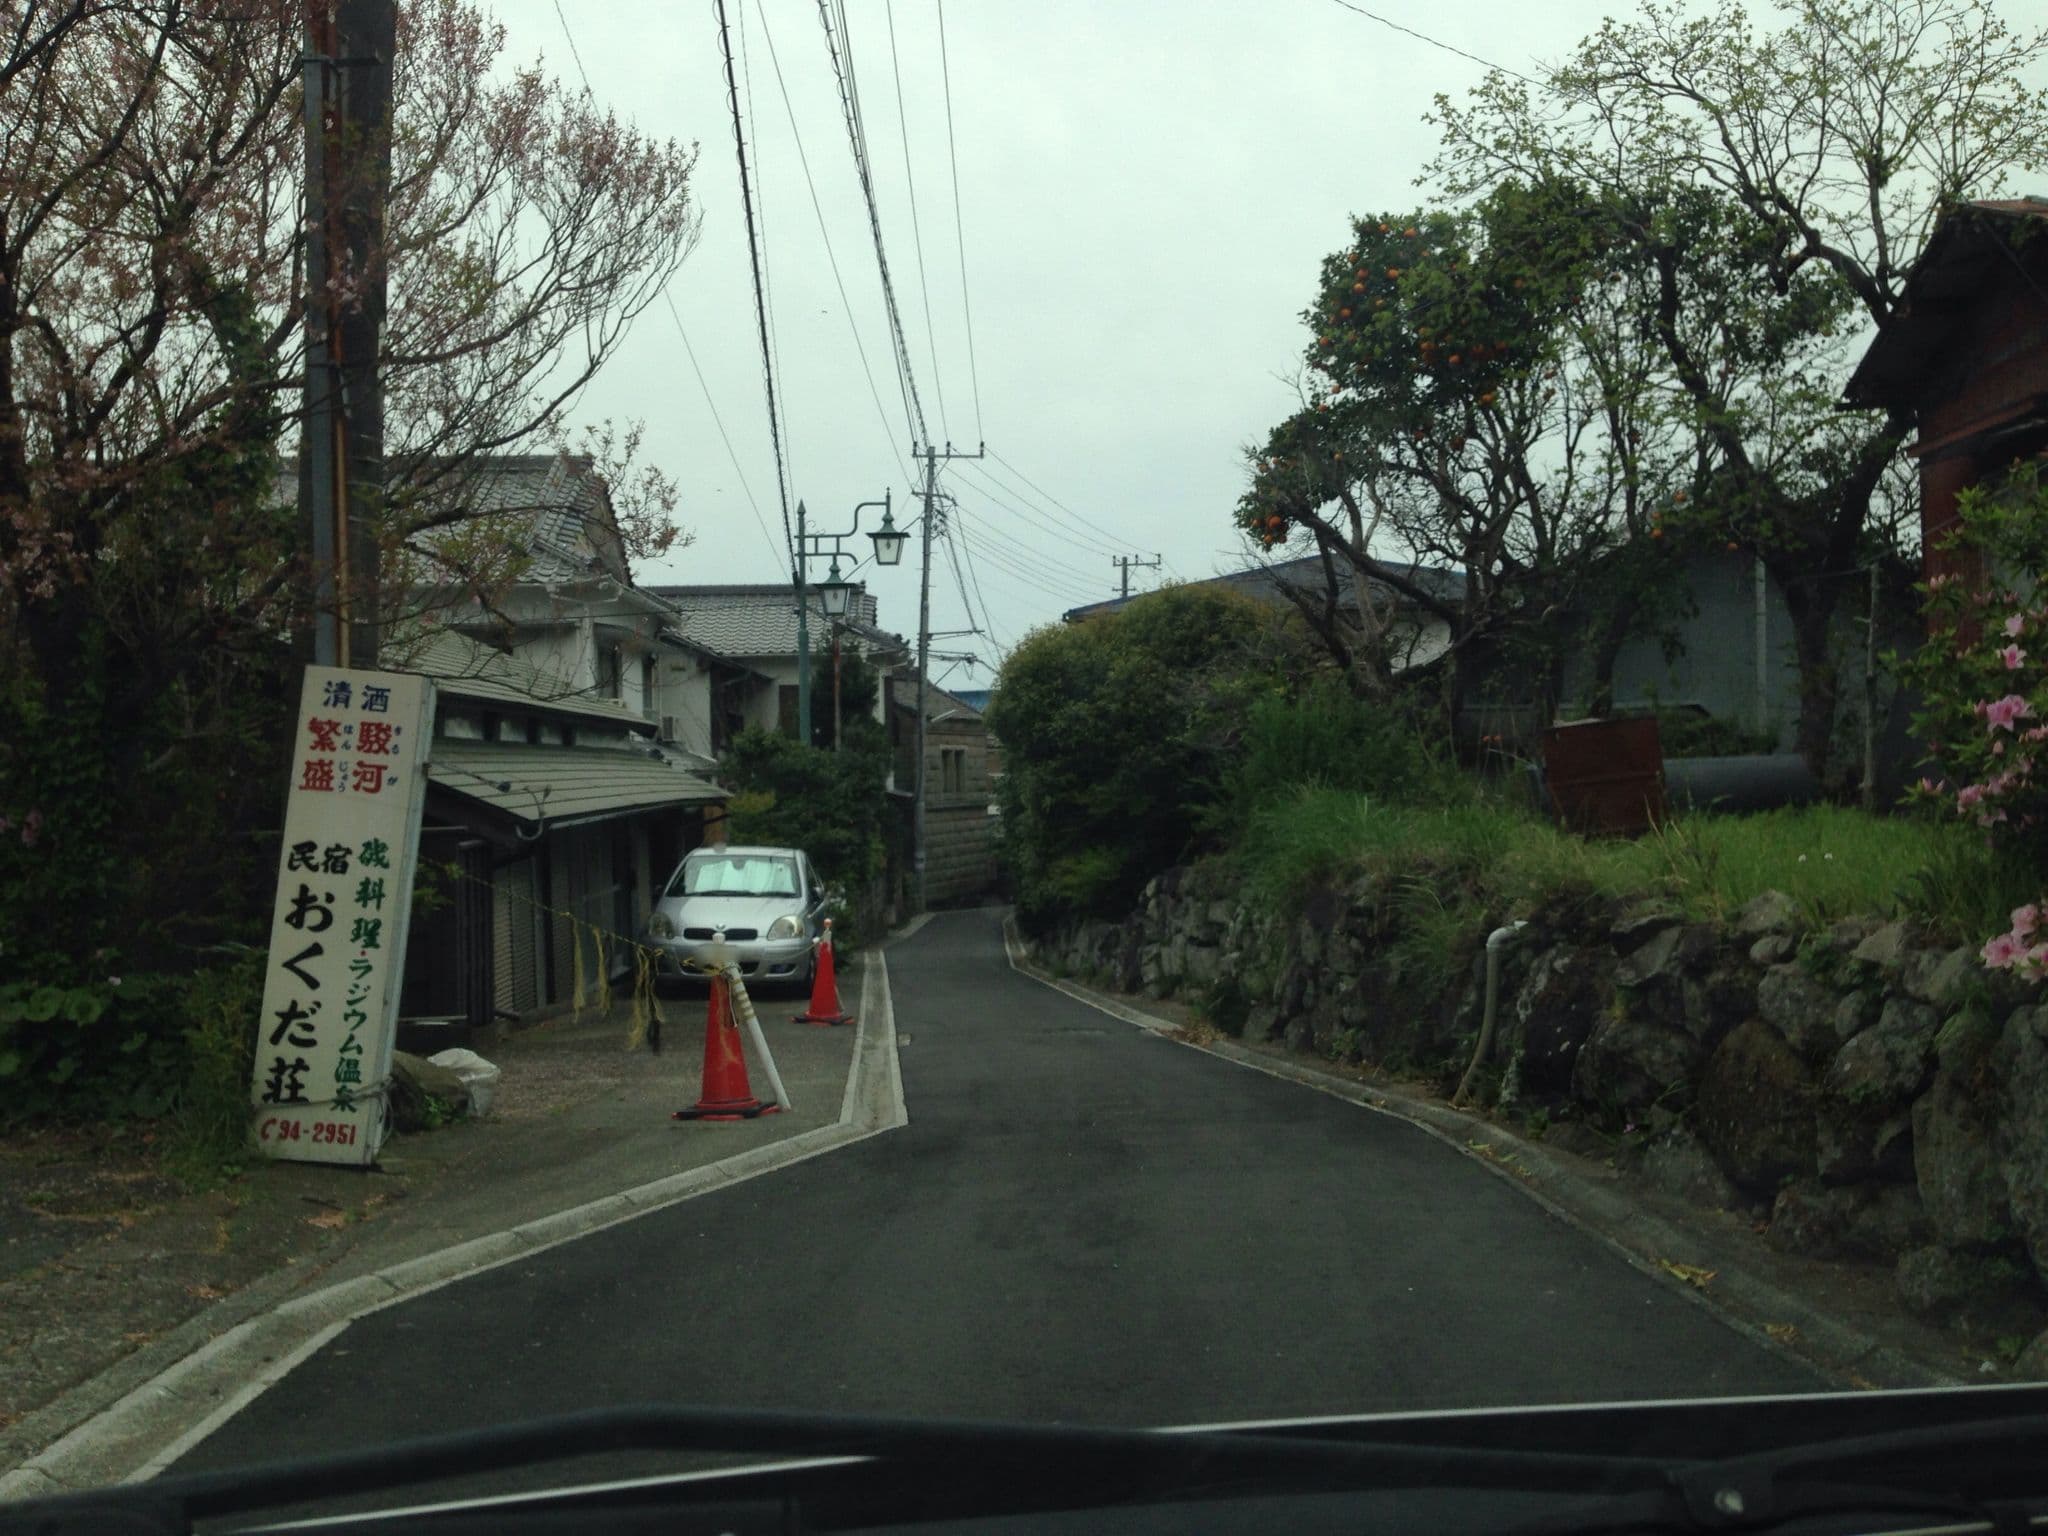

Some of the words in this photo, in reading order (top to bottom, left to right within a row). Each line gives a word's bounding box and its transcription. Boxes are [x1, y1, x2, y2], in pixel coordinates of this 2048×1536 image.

[322, 680, 391, 713] 清酒
[298, 717, 342, 792] 繁盛
[352, 720, 393, 794] 駿河
[287, 840, 352, 875] 民宿
[262, 883, 335, 1104] おくだ荘
[278, 1121, 357, 1145] 94-2951
